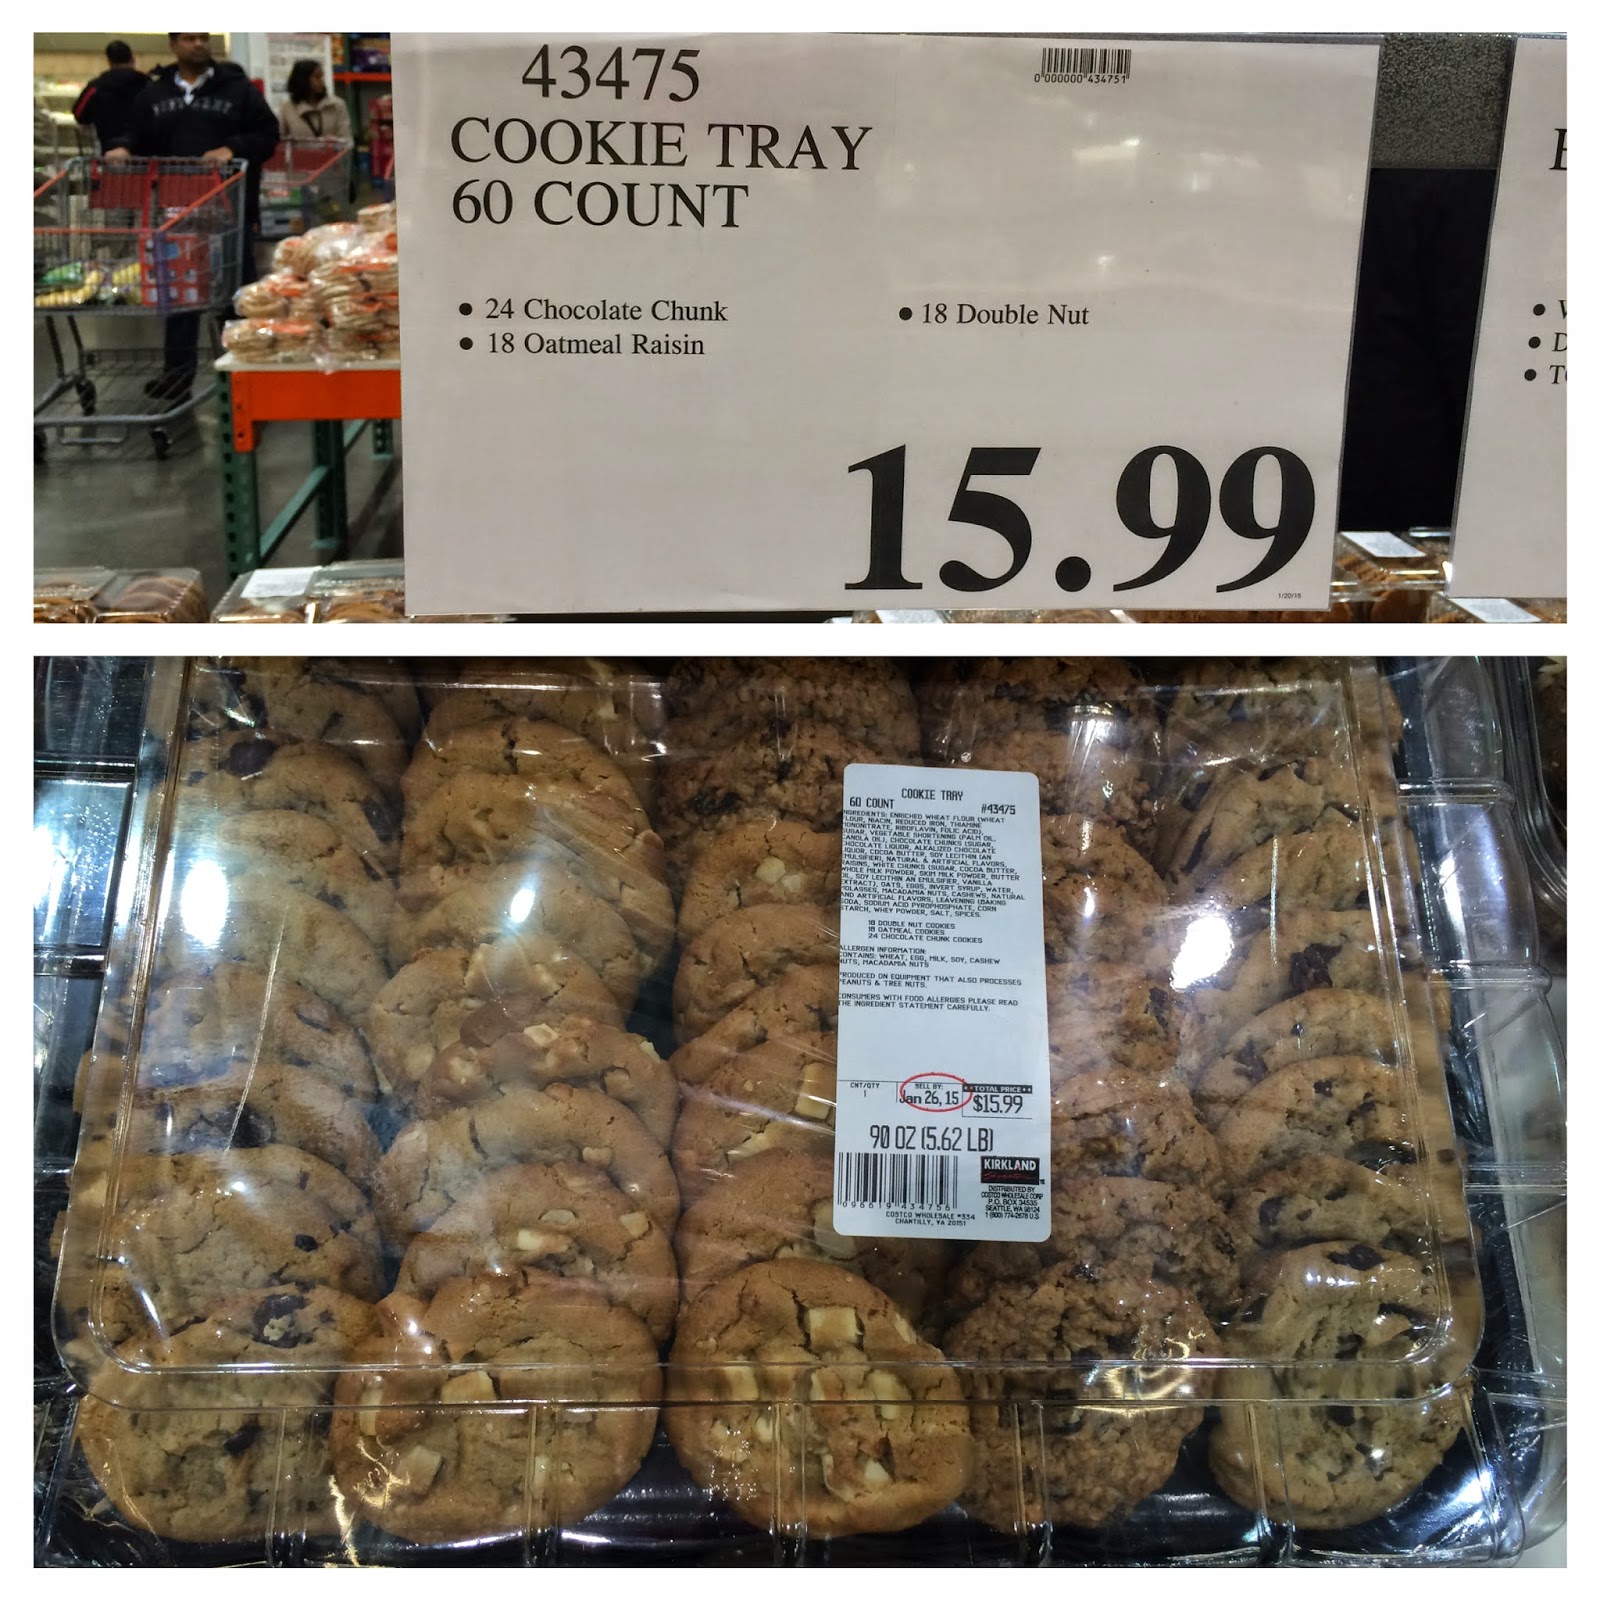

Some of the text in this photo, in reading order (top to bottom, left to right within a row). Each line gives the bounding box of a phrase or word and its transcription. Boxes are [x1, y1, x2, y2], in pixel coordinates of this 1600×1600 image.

[522, 44, 701, 102] 43475
[451, 116, 873, 171] COOKIE TRAY
[452, 179, 749, 228] 60 COUNT
[485, 298, 729, 322] 24 Chocolate Chunk
[923, 303, 1090, 325] 18 Double Nut
[489, 332, 706, 355] 18 Oatmeal Raisin
[844, 444, 1316, 593] 15.99
[901, 788, 963, 802] COOKIE TRAY
[850, 797, 894, 810] 60 COUNT
[981, 804, 1016, 815] #43475
[953, 936, 982, 944] COOKIES
[877, 946, 927, 954] INFORMATION:
[862, 959, 906, 967] MACADAMIA
[879, 954, 907, 962] WHEAT,
[951, 956, 966, 964] SOY,
[899, 1002, 944, 1010] STATEMENT
[927, 996, 965, 1004] ALLERGIES
[899, 1090, 959, 1106] Jan 26, 15
[973, 1094, 1023, 1114] $15.99
[870, 1125, 994, 1151] 90 OZ (5.62 LB)
[984, 1159, 1037, 1171] KIRKLAND
[988, 1185, 1027, 1193] DISTRIBUTED
